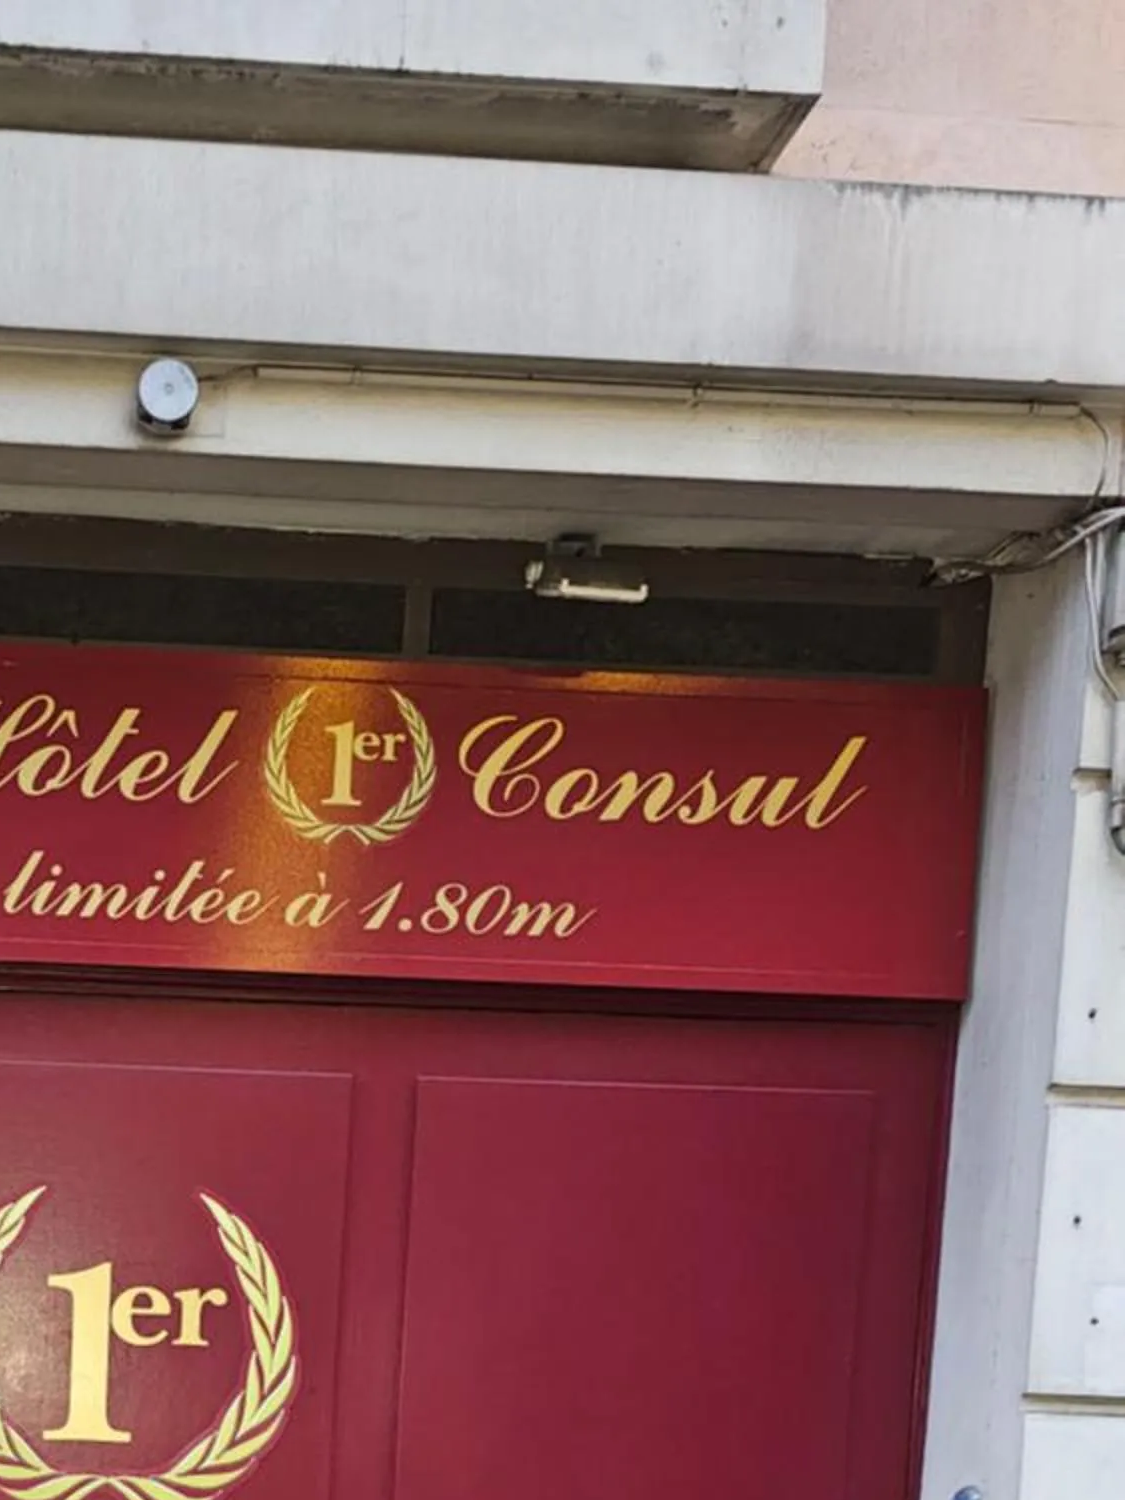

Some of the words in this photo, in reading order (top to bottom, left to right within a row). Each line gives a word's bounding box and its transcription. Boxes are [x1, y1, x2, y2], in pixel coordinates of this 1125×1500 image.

[320, 719, 407, 809] 1er
[457, 714, 868, 830] Consul
[3, 850, 280, 925] limitée
[283, 871, 347, 929] à
[359, 881, 597, 938] 1.80m
[42, 1261, 229, 1444] 1er
